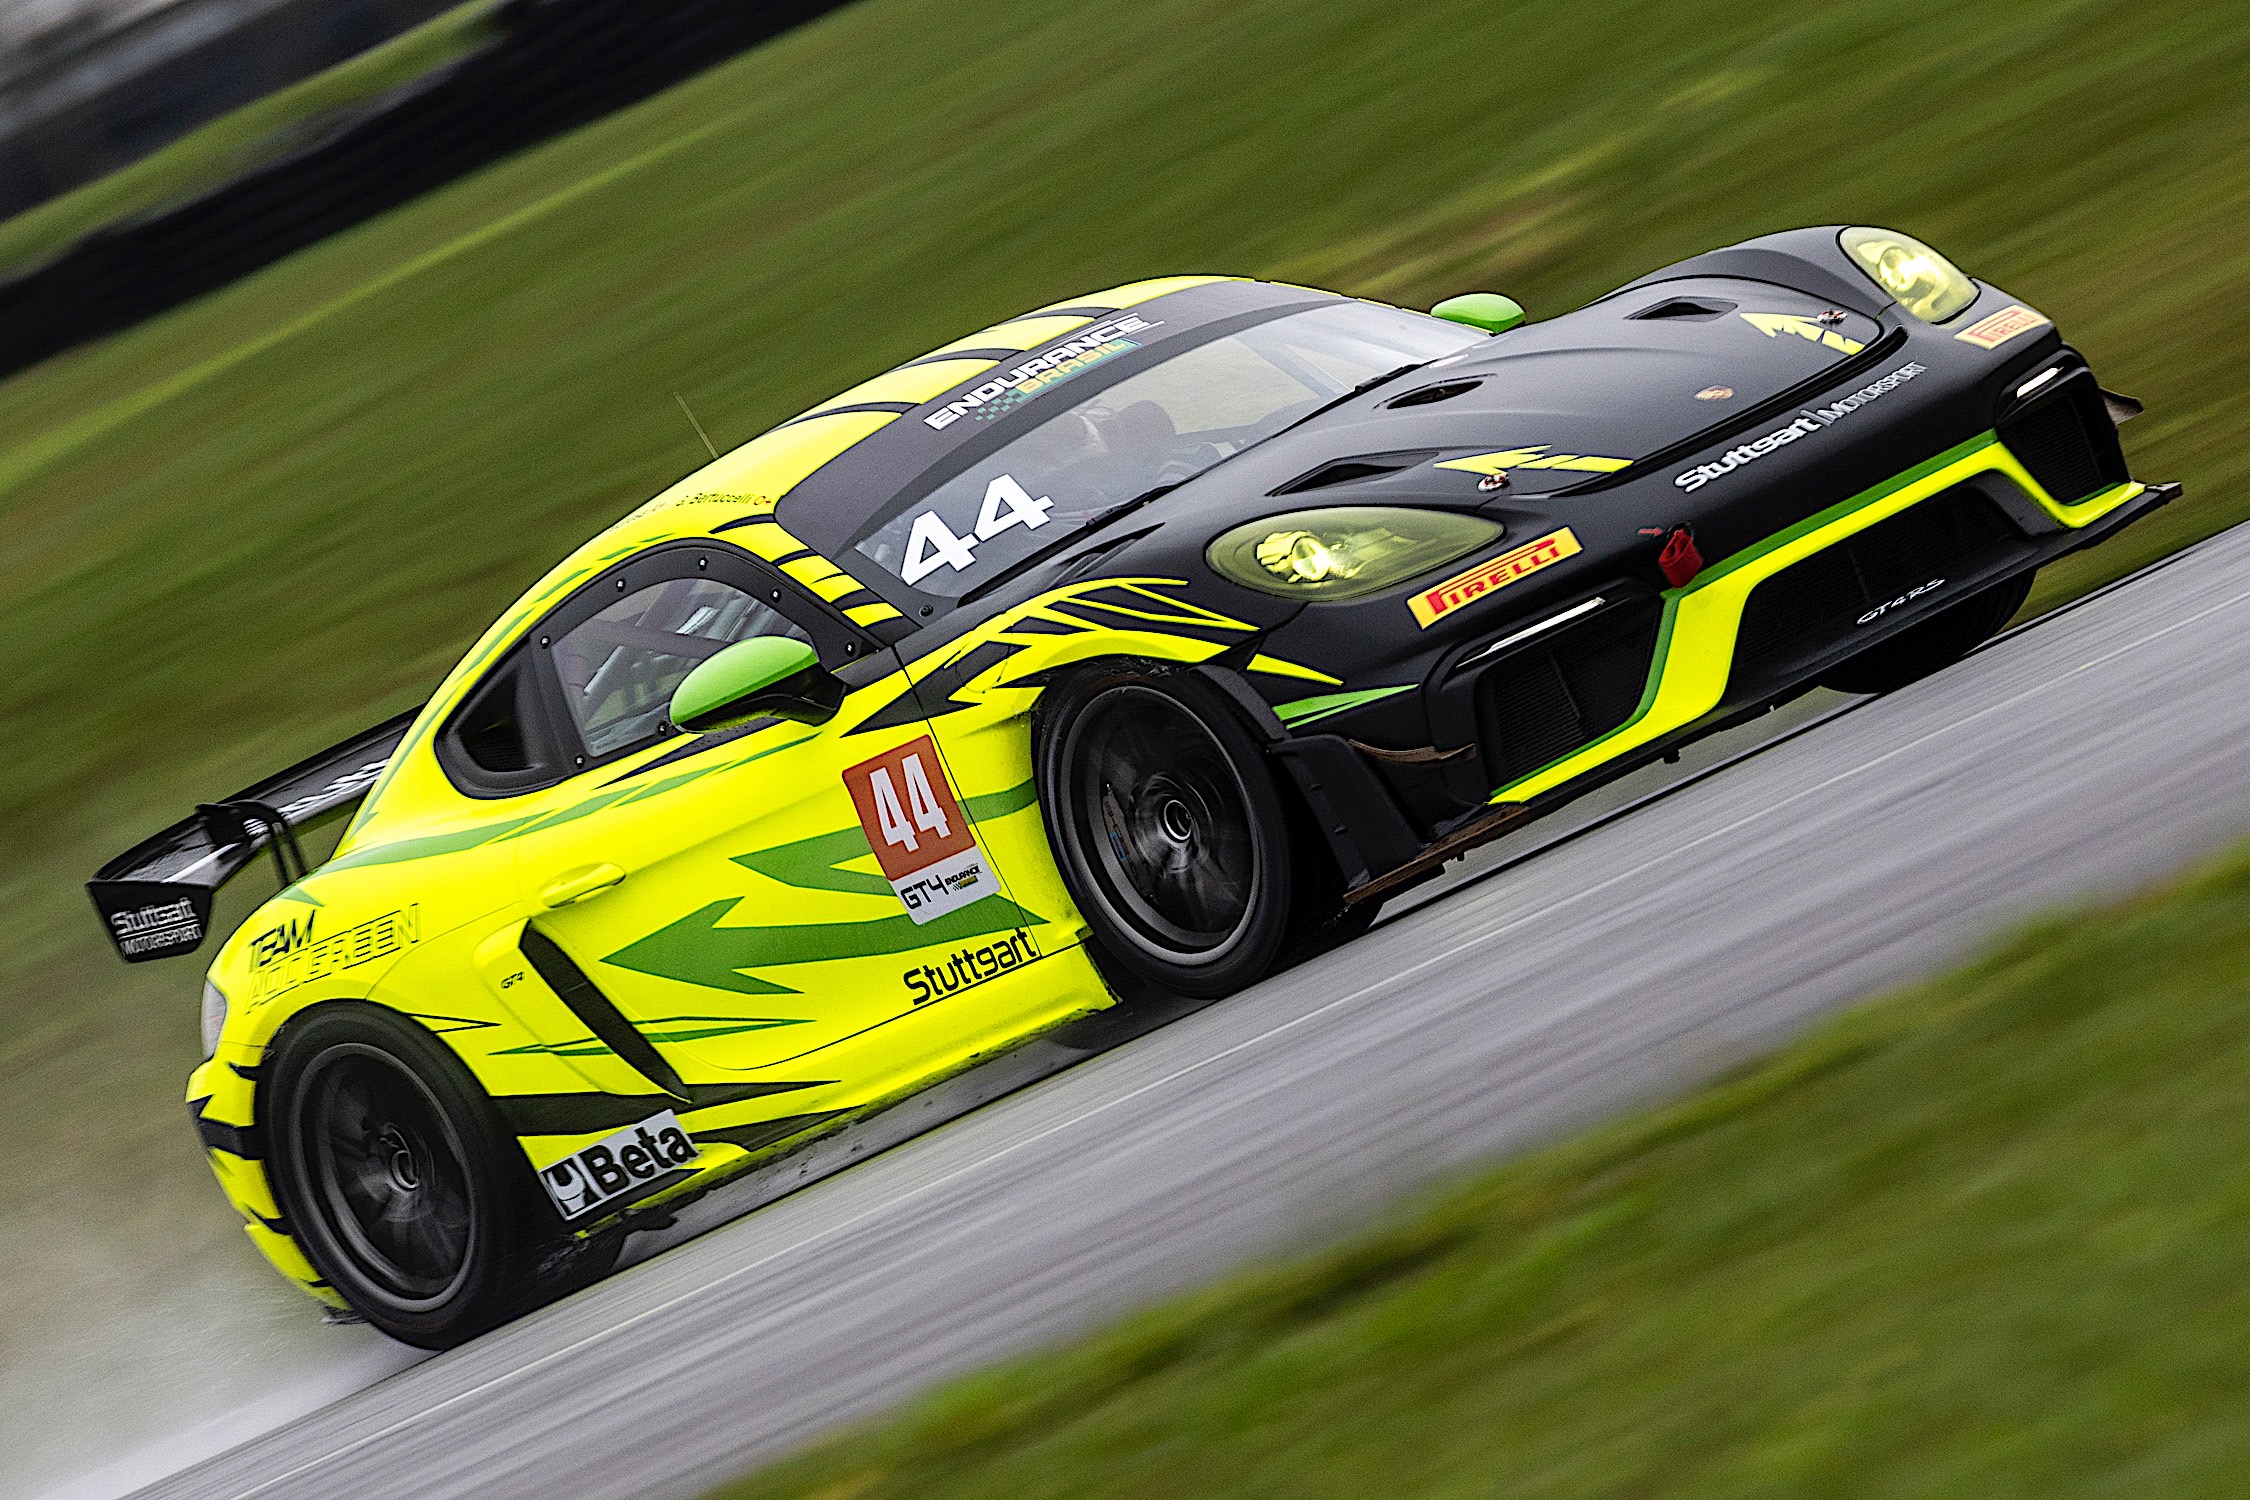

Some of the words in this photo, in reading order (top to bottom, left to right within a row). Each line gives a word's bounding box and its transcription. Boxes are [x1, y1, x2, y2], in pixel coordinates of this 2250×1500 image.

[923, 313, 1152, 431] ENDURANCE
[1014, 339, 1127, 395] BRASIL
[900, 473, 1054, 587] 44
[1426, 538, 1561, 615] PIRELLI
[869, 753, 951, 853] 44
[900, 874, 950, 910] GT4
[249, 909, 316, 973] TEAM
[903, 927, 1037, 1005] Stuttgart
[577, 1126, 700, 1196] Beta
